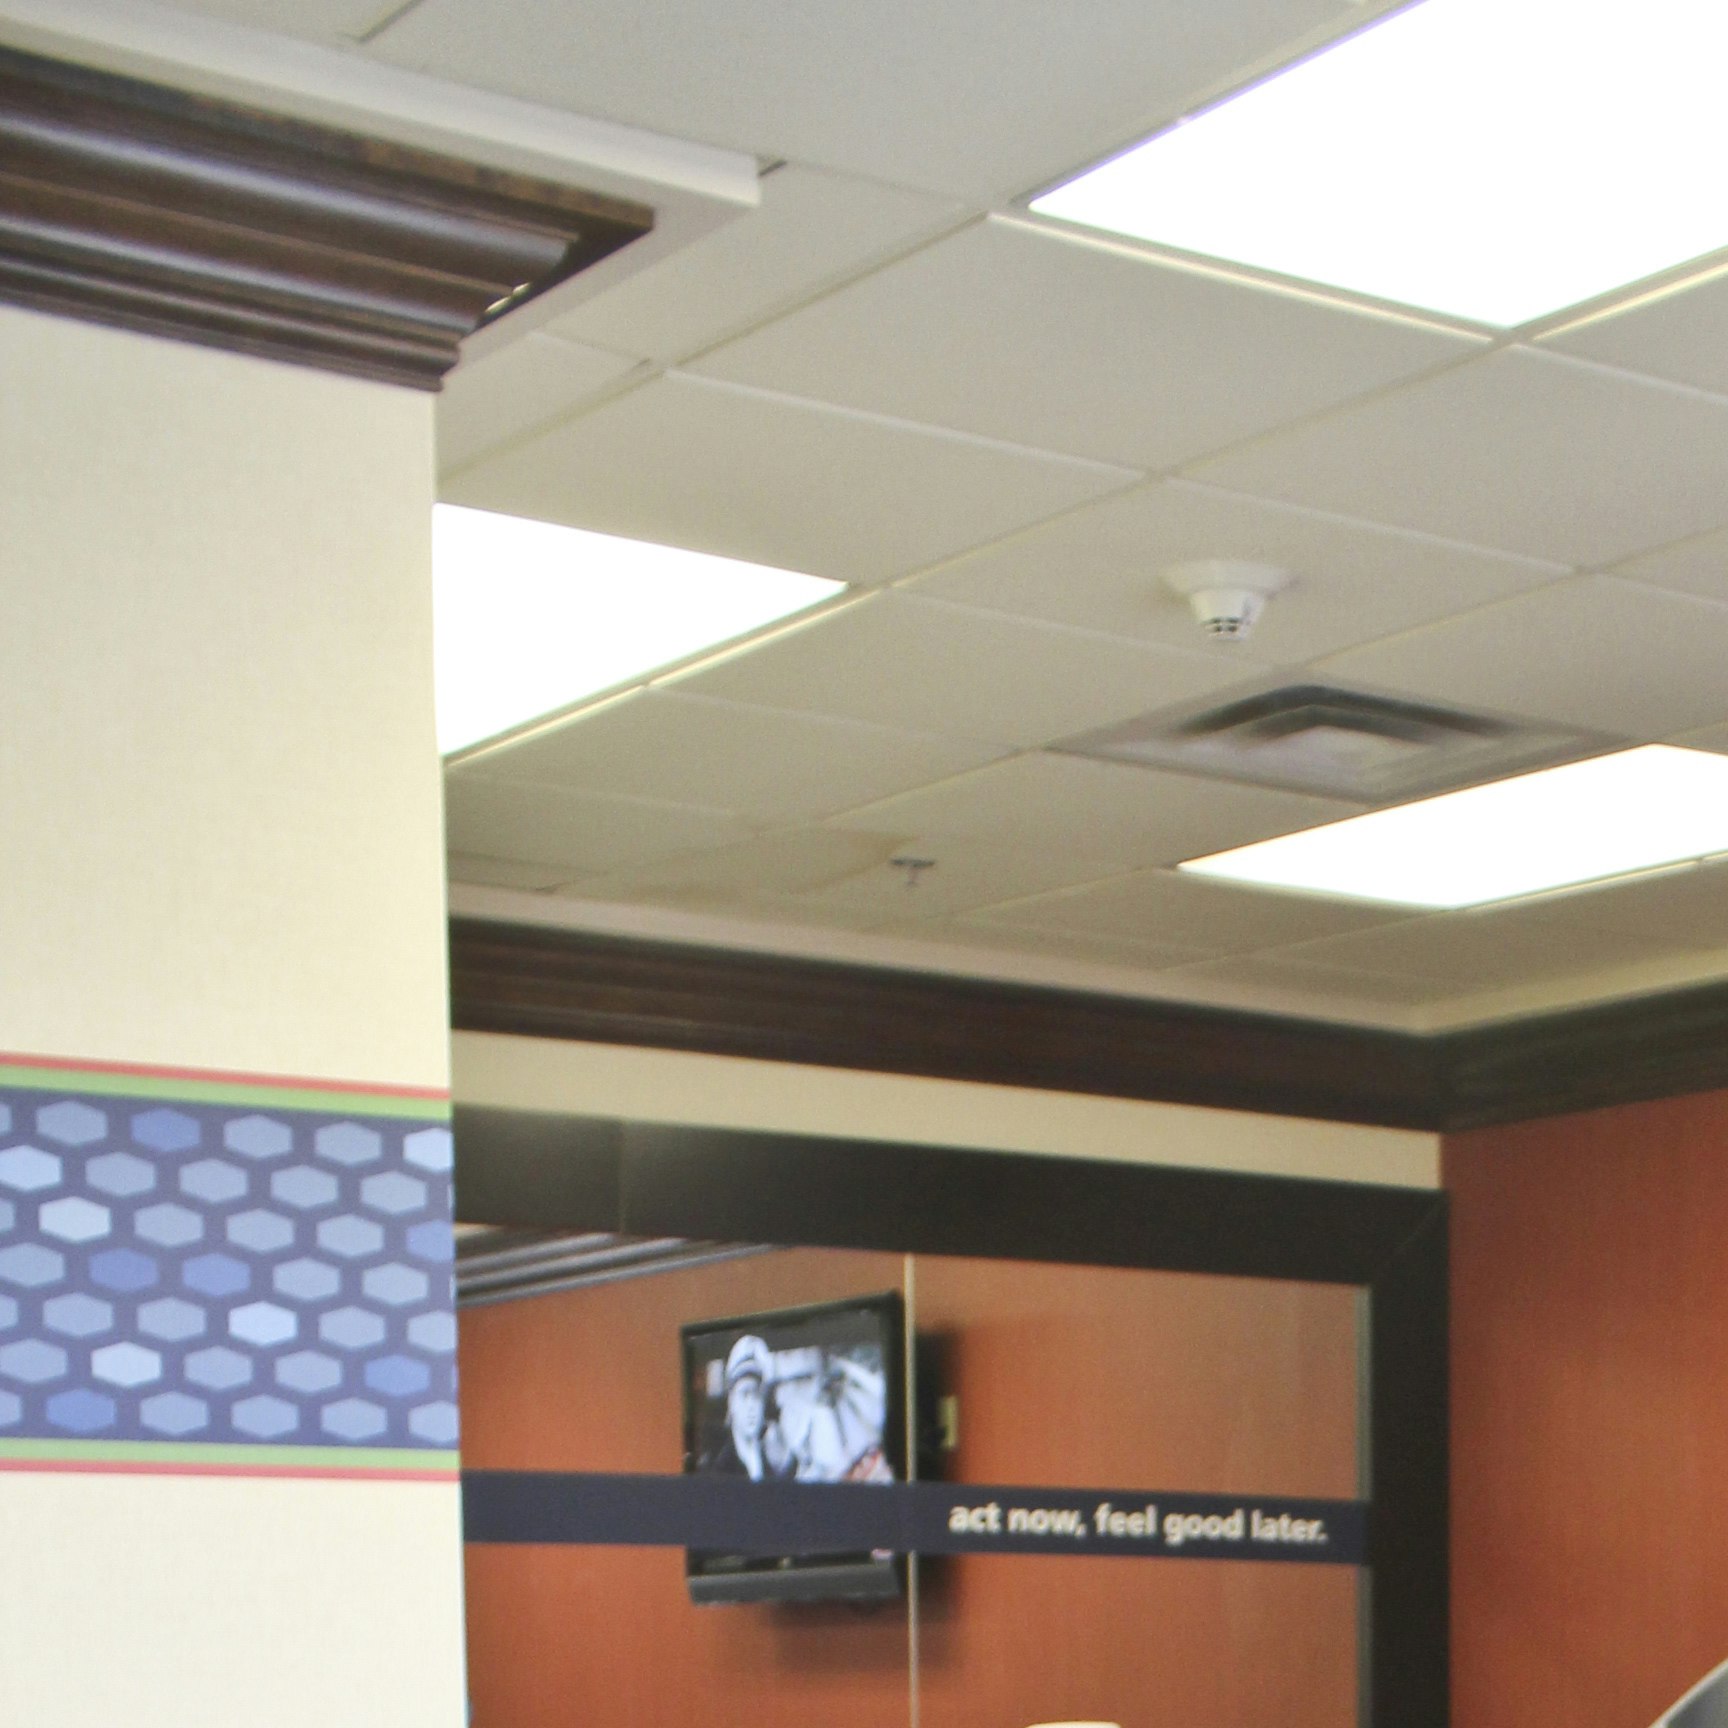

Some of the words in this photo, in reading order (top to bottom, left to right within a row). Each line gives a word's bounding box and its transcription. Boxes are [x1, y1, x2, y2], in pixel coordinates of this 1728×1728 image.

[949, 1504, 1001, 1534] act
[1008, 1507, 1085, 1538] now,
[1095, 1503, 1157, 1537] feel
[1164, 1509, 1244, 1545] good
[1251, 1510, 1329, 1544] later.
